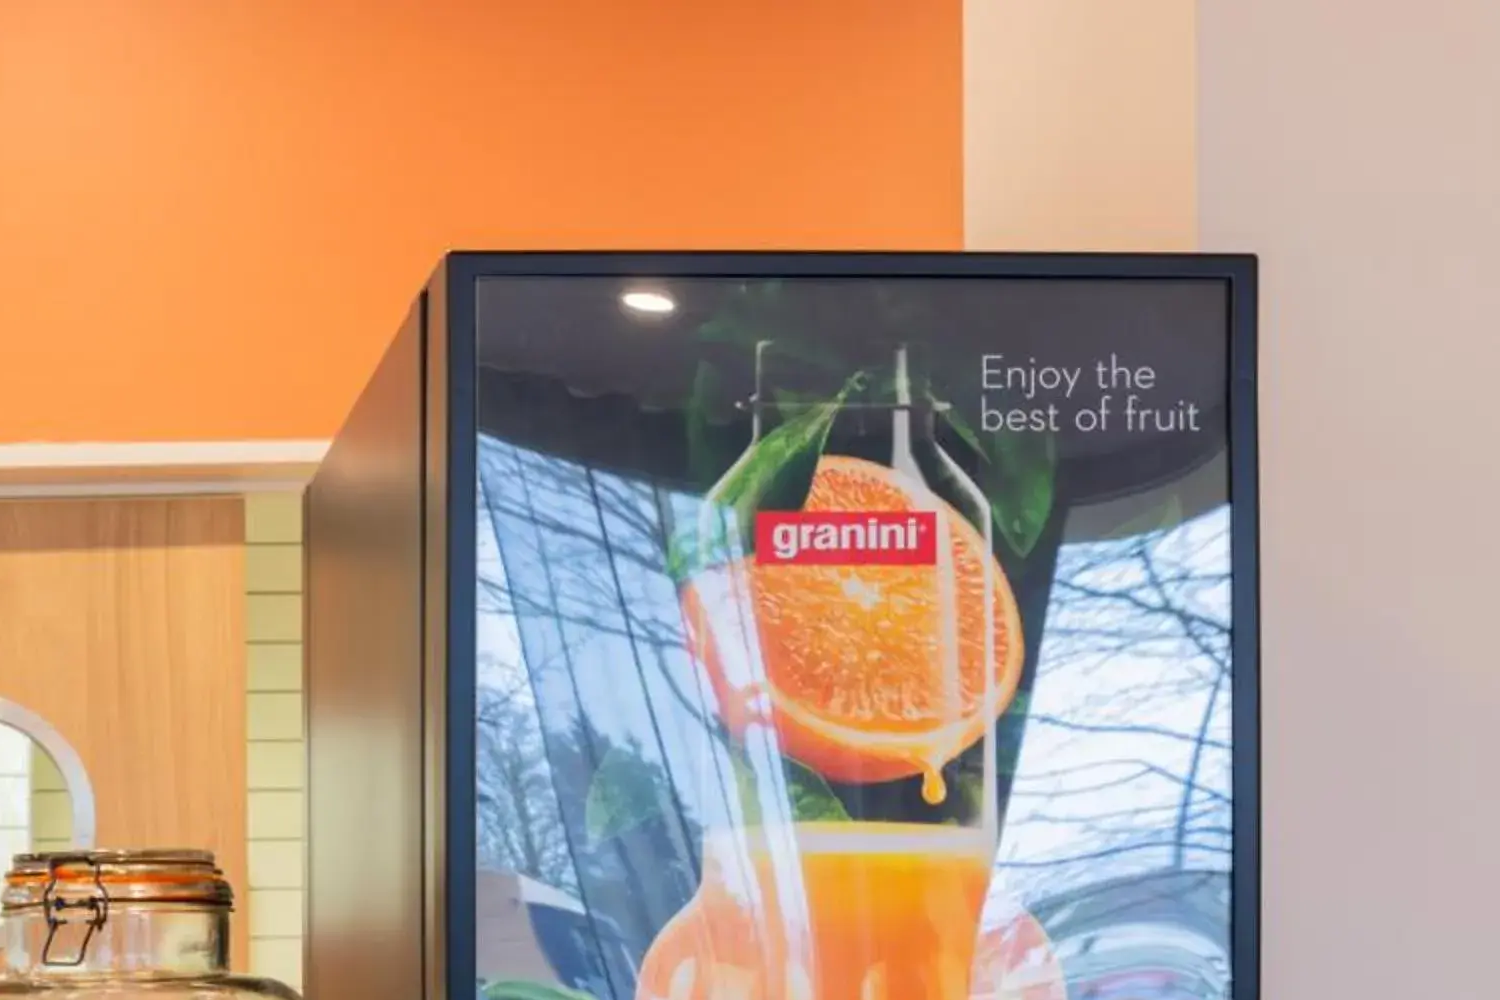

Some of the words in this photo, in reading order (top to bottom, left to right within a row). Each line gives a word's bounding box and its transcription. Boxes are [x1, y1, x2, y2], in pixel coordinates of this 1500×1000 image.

[980, 353, 1081, 398] Enjoy
[1096, 354, 1156, 389] the
[979, 398, 1061, 433] best
[1074, 397, 1112, 432] of
[1123, 397, 1201, 432] fruit
[772, 517, 919, 560] granini
